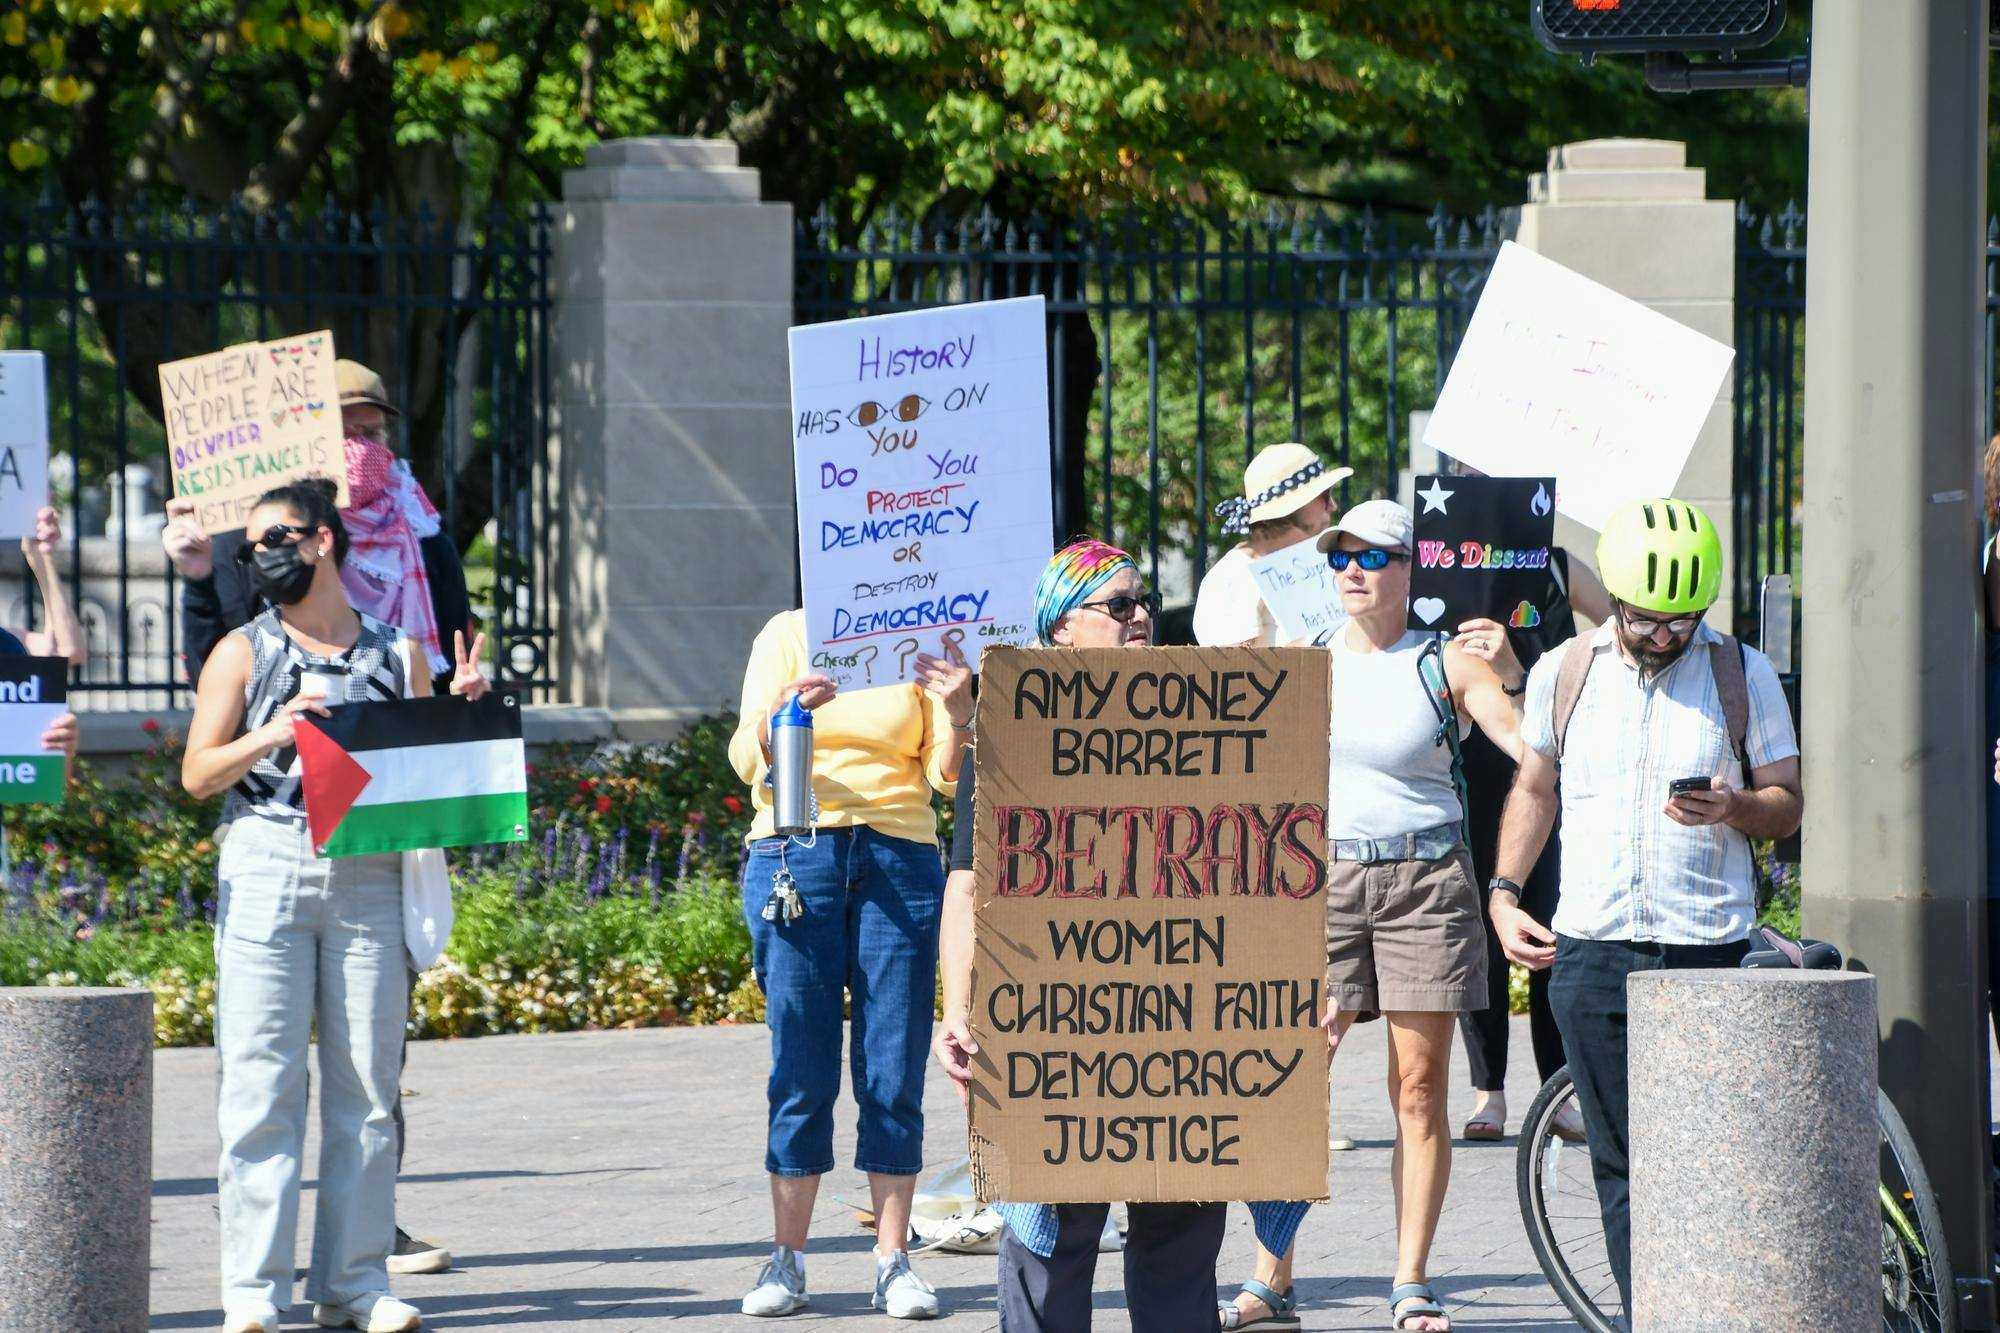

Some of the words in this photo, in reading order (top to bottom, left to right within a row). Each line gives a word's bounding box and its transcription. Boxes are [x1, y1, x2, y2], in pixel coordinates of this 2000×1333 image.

[165, 352, 258, 400] WHEN
[170, 385, 260, 438] PEOPLE
[267, 365, 318, 407] ARE
[797, 410, 841, 438] HAS
[944, 383, 989, 411] ON
[176, 445, 303, 496] RESISTANCE
[308, 436, 328, 465] IS
[866, 483, 966, 515] PROTECT
[822, 500, 980, 551] DEMOCRACY
[893, 541, 921, 563] OR
[1418, 540, 1455, 569] We
[1460, 541, 1549, 569] Dissent
[853, 571, 939, 600] DESTROY
[1260, 566, 1296, 593] The
[832, 589, 990, 639] DEMOCRACY
[893, 637, 919, 680] ?
[1014, 668, 1119, 720] AMY
[1125, 670, 1289, 722] CONEY
[1052, 728, 1267, 777] BARRETT
[992, 802, 1329, 900] BETRAYS
[1048, 915, 1225, 967] WOMEN
[988, 981, 1193, 1035] CHRISTIAN
[1214, 978, 1320, 1031] FAITH
[1007, 1048, 1304, 1100] DEMOCRACY
[1043, 1115, 1240, 1166] JUSTICE
